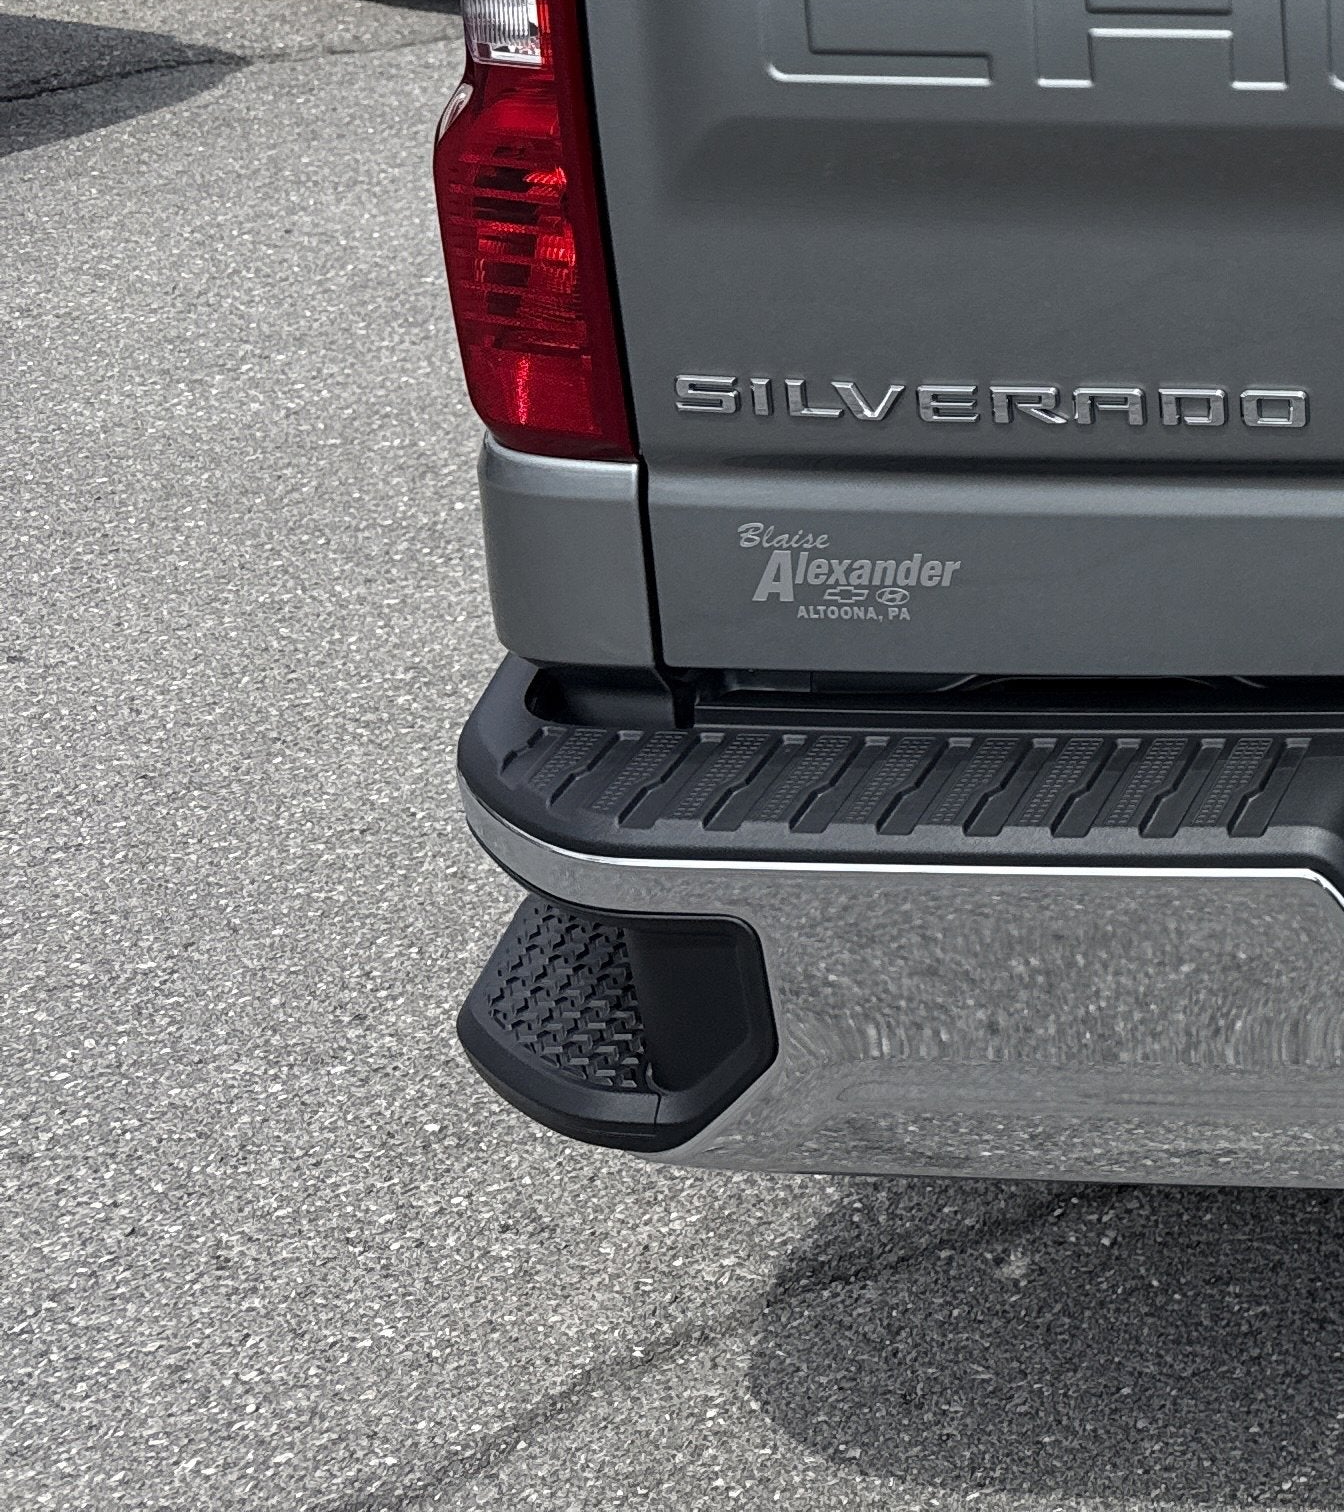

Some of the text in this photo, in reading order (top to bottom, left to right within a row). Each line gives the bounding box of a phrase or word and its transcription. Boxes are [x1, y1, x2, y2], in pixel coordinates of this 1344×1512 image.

[674, 374, 1311, 428] SILVERADO
[737, 522, 830, 549] Blaise
[752, 549, 962, 602] Alexander
[797, 605, 911, 622] ALTOONA, PA
